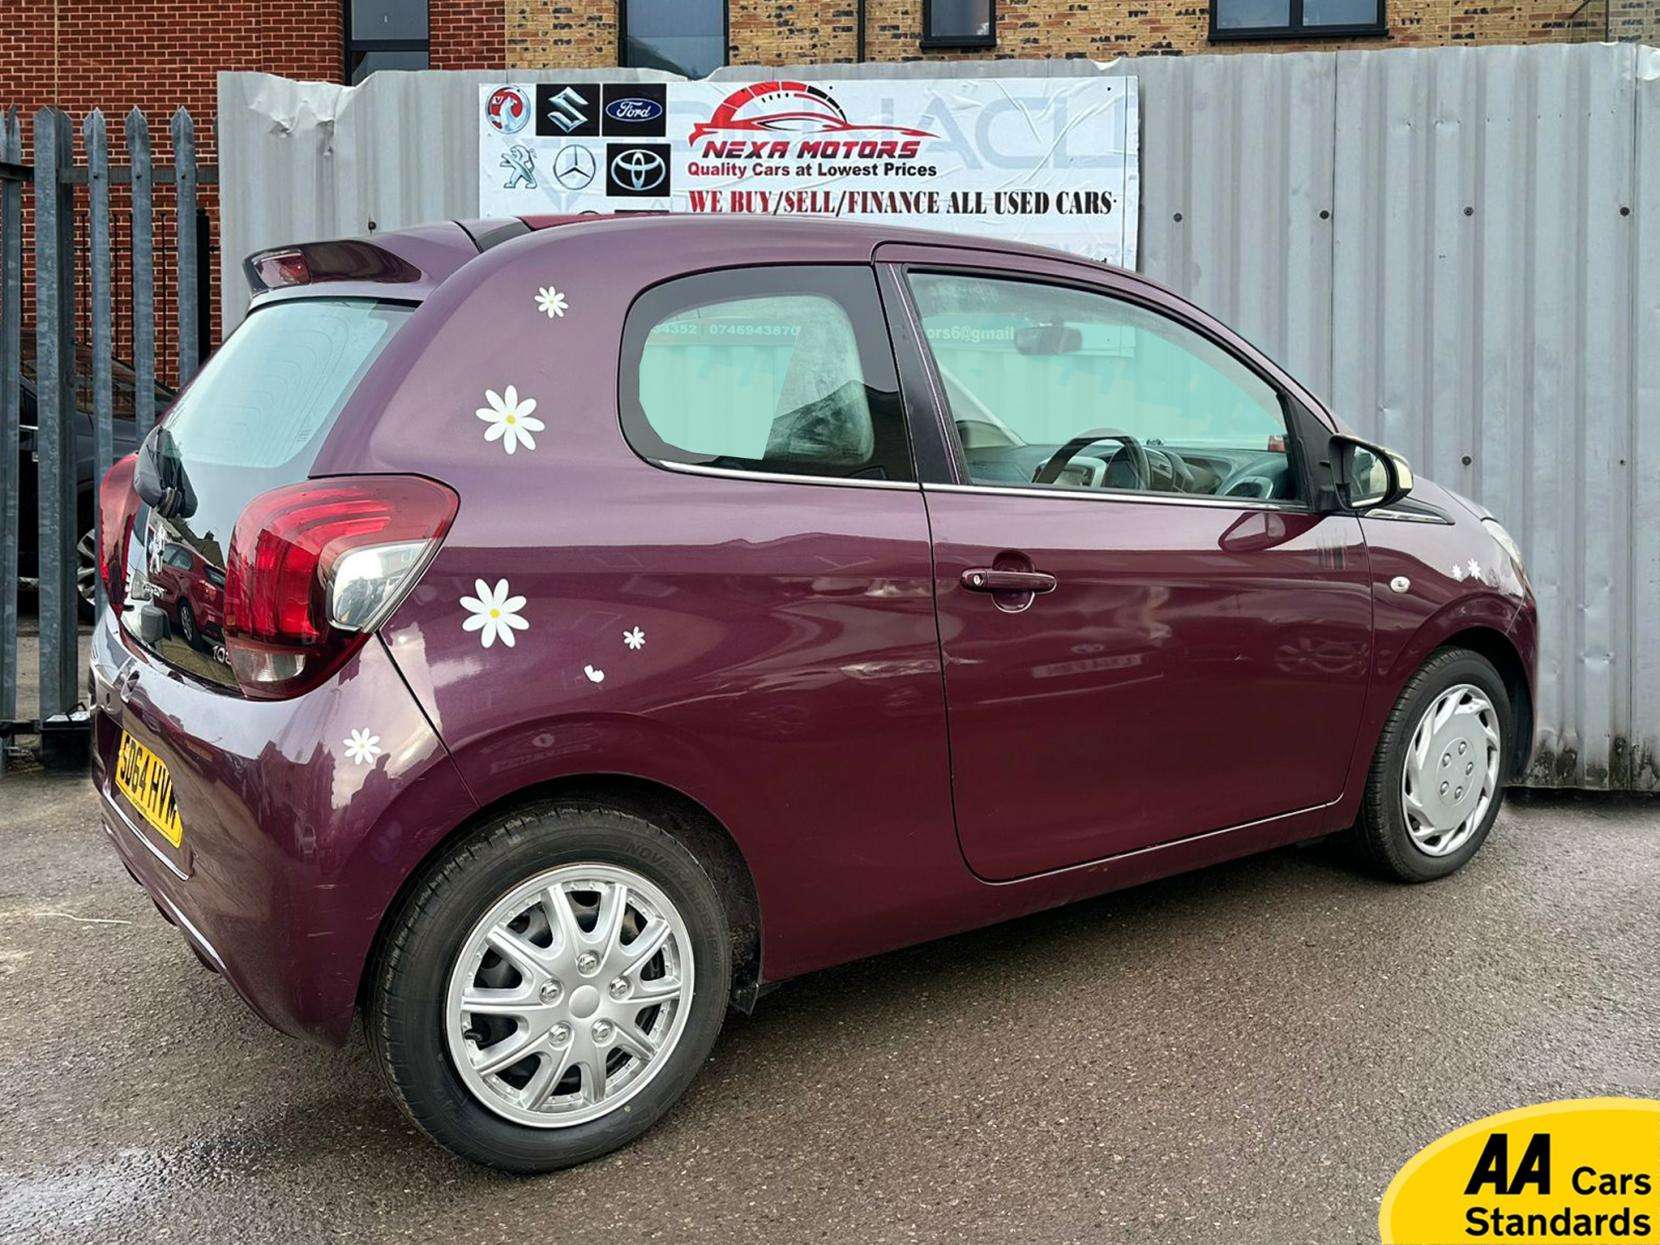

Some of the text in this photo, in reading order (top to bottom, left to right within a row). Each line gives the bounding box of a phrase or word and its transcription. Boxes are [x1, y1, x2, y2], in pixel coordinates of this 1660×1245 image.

[616, 101, 652, 118] Ford
[702, 141, 921, 159] NEXA MOTORS
[688, 161, 938, 178] Quality Cars at Lowest Prices
[688, 190, 723, 214] WE
[946, 191, 988, 215] ALL
[993, 191, 1050, 215] USED
[1056, 191, 1113, 215] CARS
